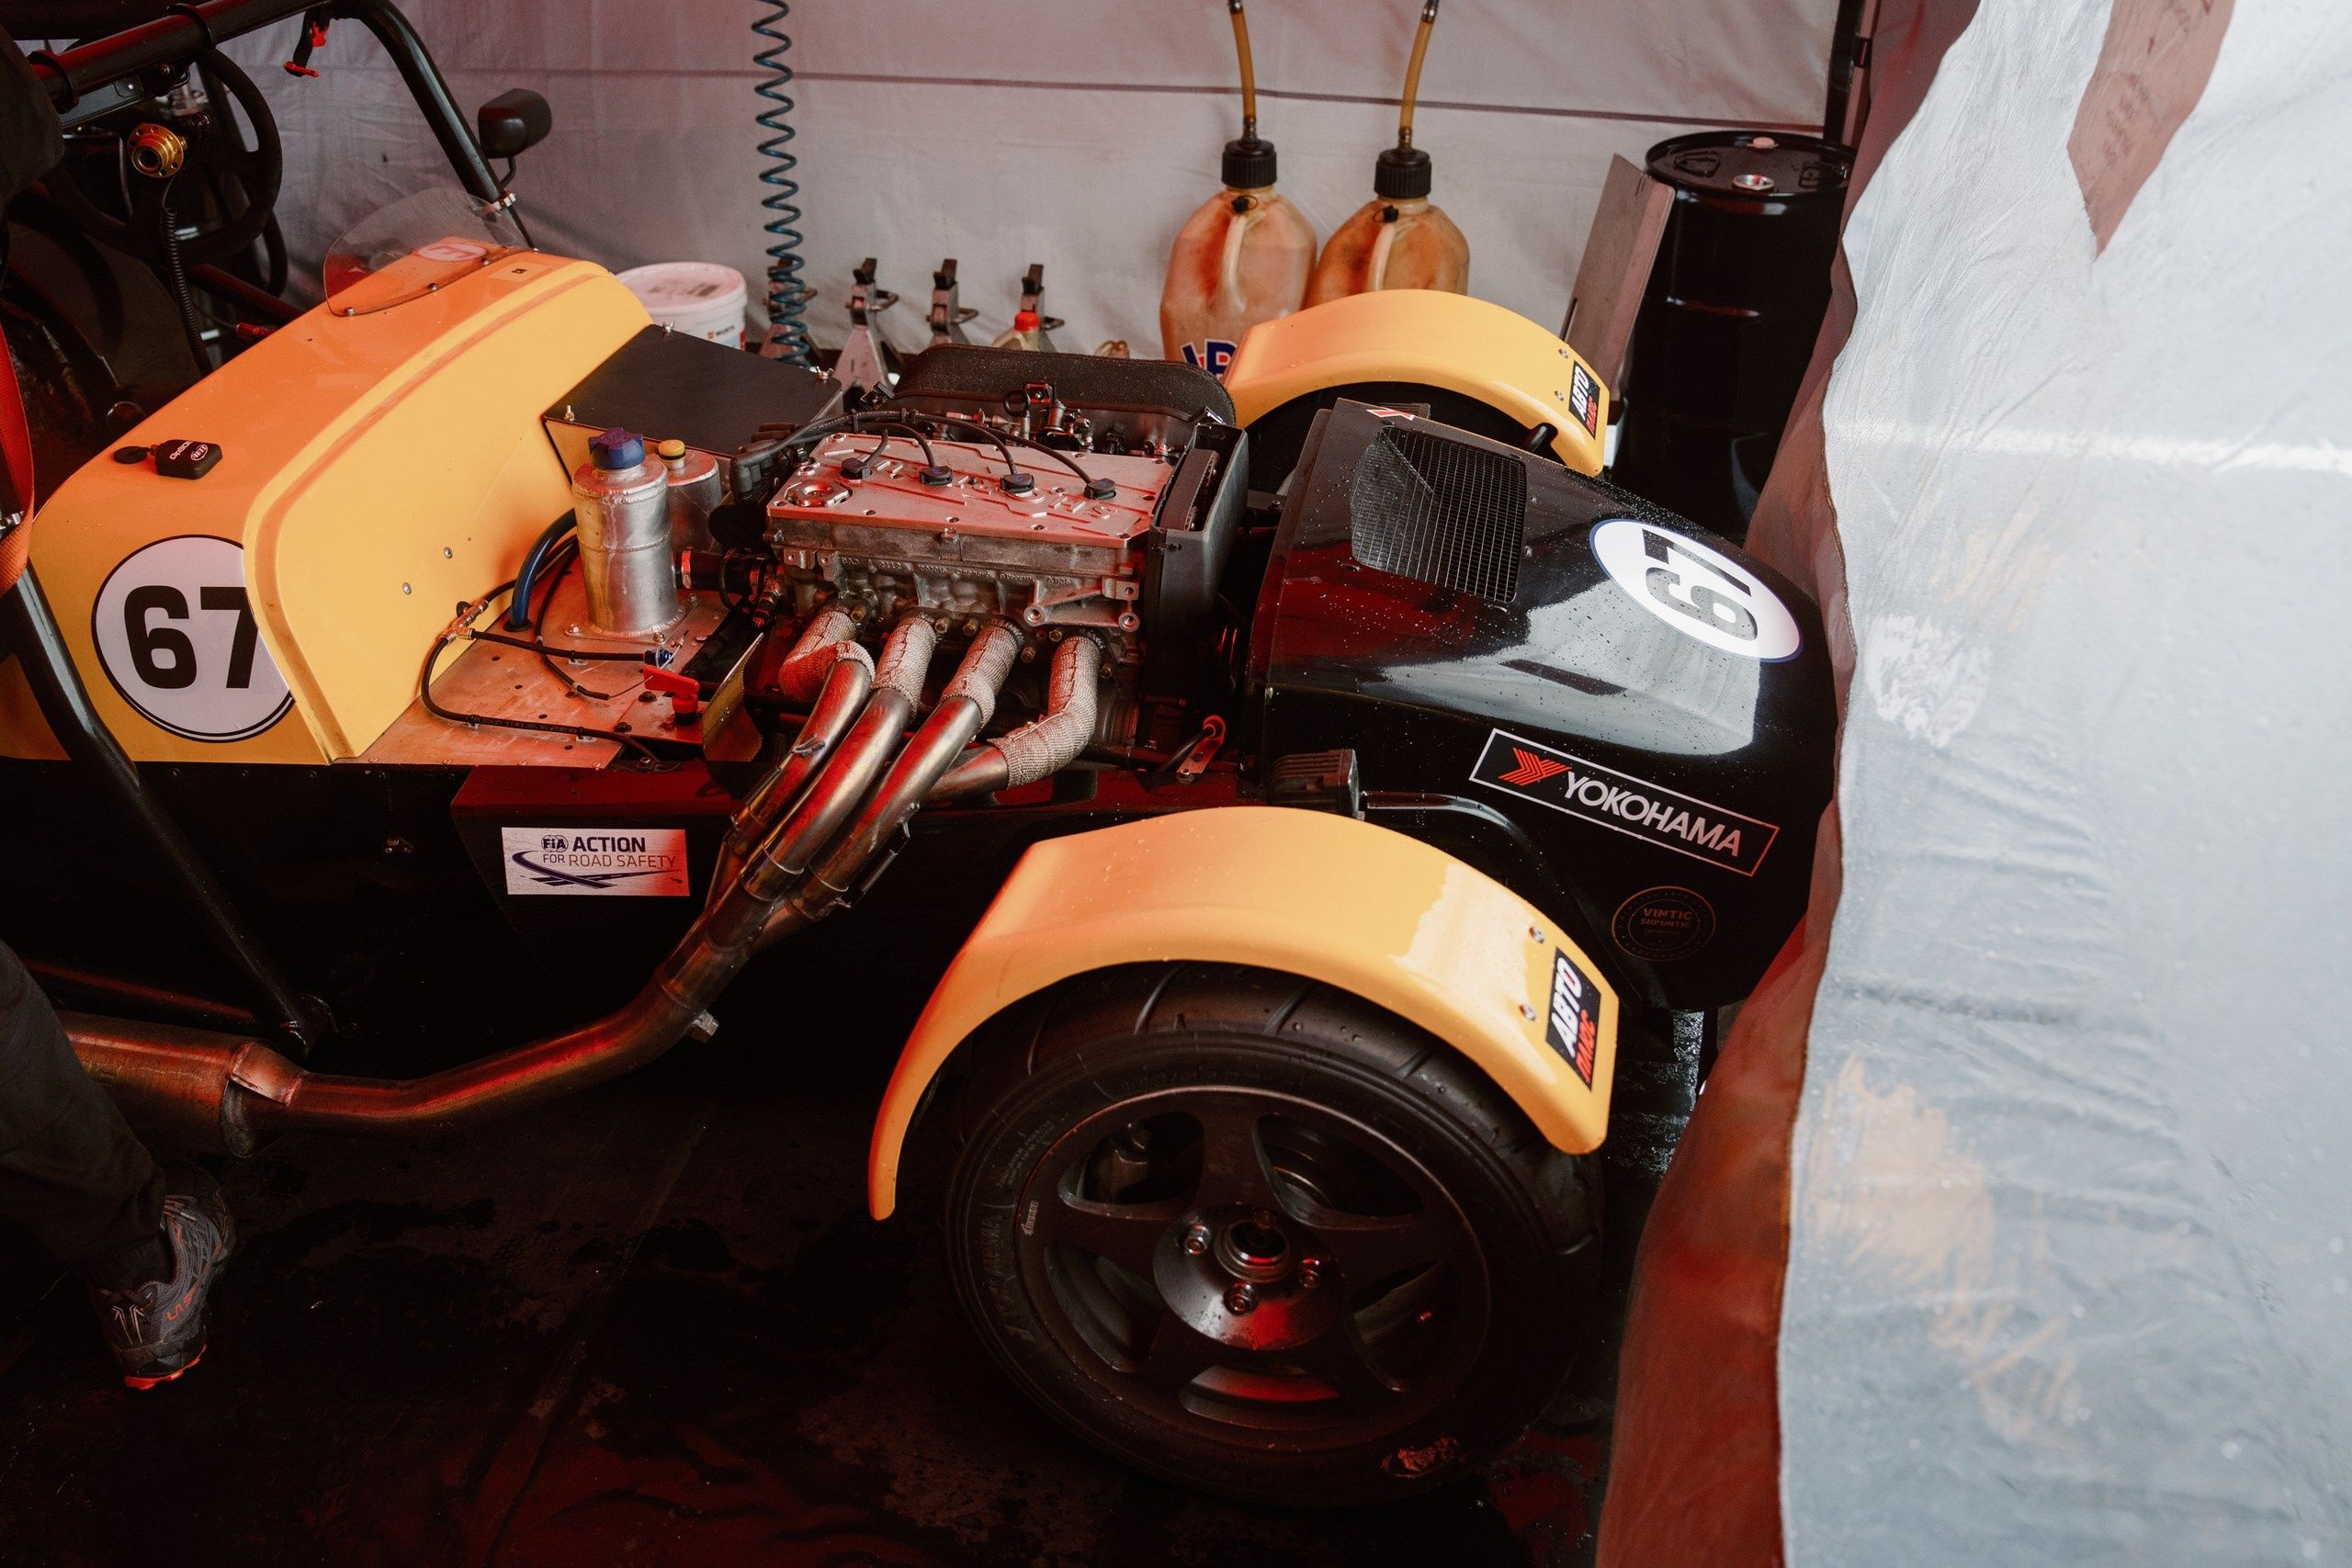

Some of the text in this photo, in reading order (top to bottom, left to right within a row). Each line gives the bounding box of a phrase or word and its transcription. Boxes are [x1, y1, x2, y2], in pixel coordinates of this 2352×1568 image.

[1571, 366, 1589, 422] АВТО
[1641, 528, 1758, 641] 67
[124, 585, 259, 689] 67
[572, 836, 646, 852] ACTION
[1564, 772, 1741, 857] YOKOHAMA
[543, 853, 676, 868] FOR ROAD SAFETY
[1643, 908, 1692, 920] VINTIC
[1551, 957, 1582, 1058] АВТО
[1576, 1009, 1597, 1084] ПЛЮС
